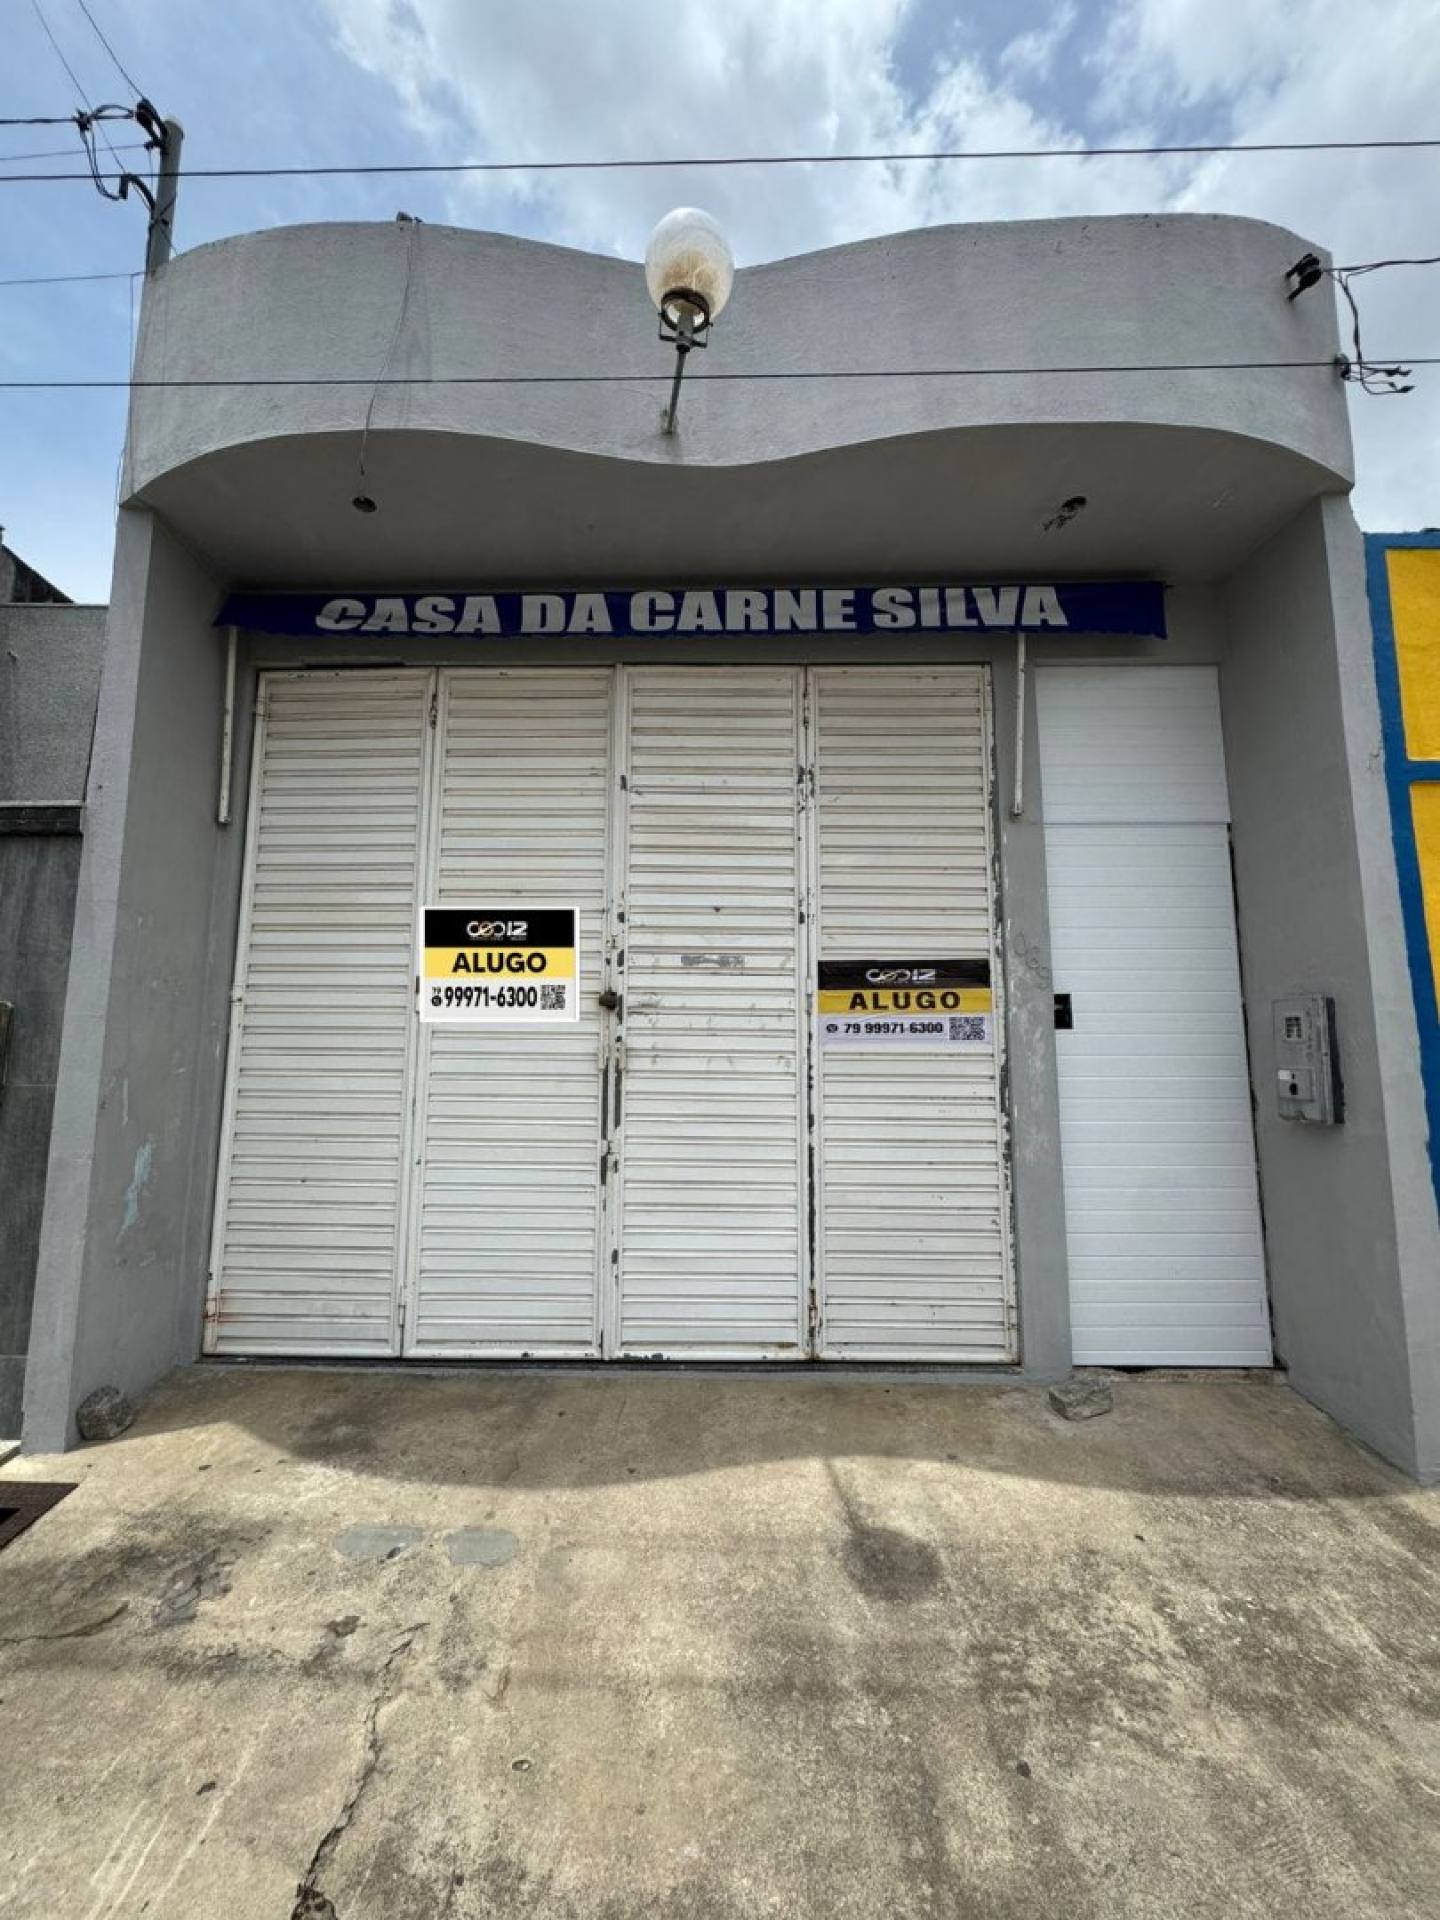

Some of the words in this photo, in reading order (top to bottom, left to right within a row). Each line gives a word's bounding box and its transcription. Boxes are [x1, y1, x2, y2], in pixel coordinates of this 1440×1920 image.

[315, 595, 501, 634] CASA
[520, 594, 613, 634] DA
[629, 590, 857, 632] CARNE
[872, 586, 1069, 628] SILVA
[452, 952, 547, 973] ALUGO
[444, 986, 538, 1008] 99971-6300
[849, 991, 961, 1010] ALUGO
[844, 1023, 861, 1034] 79
